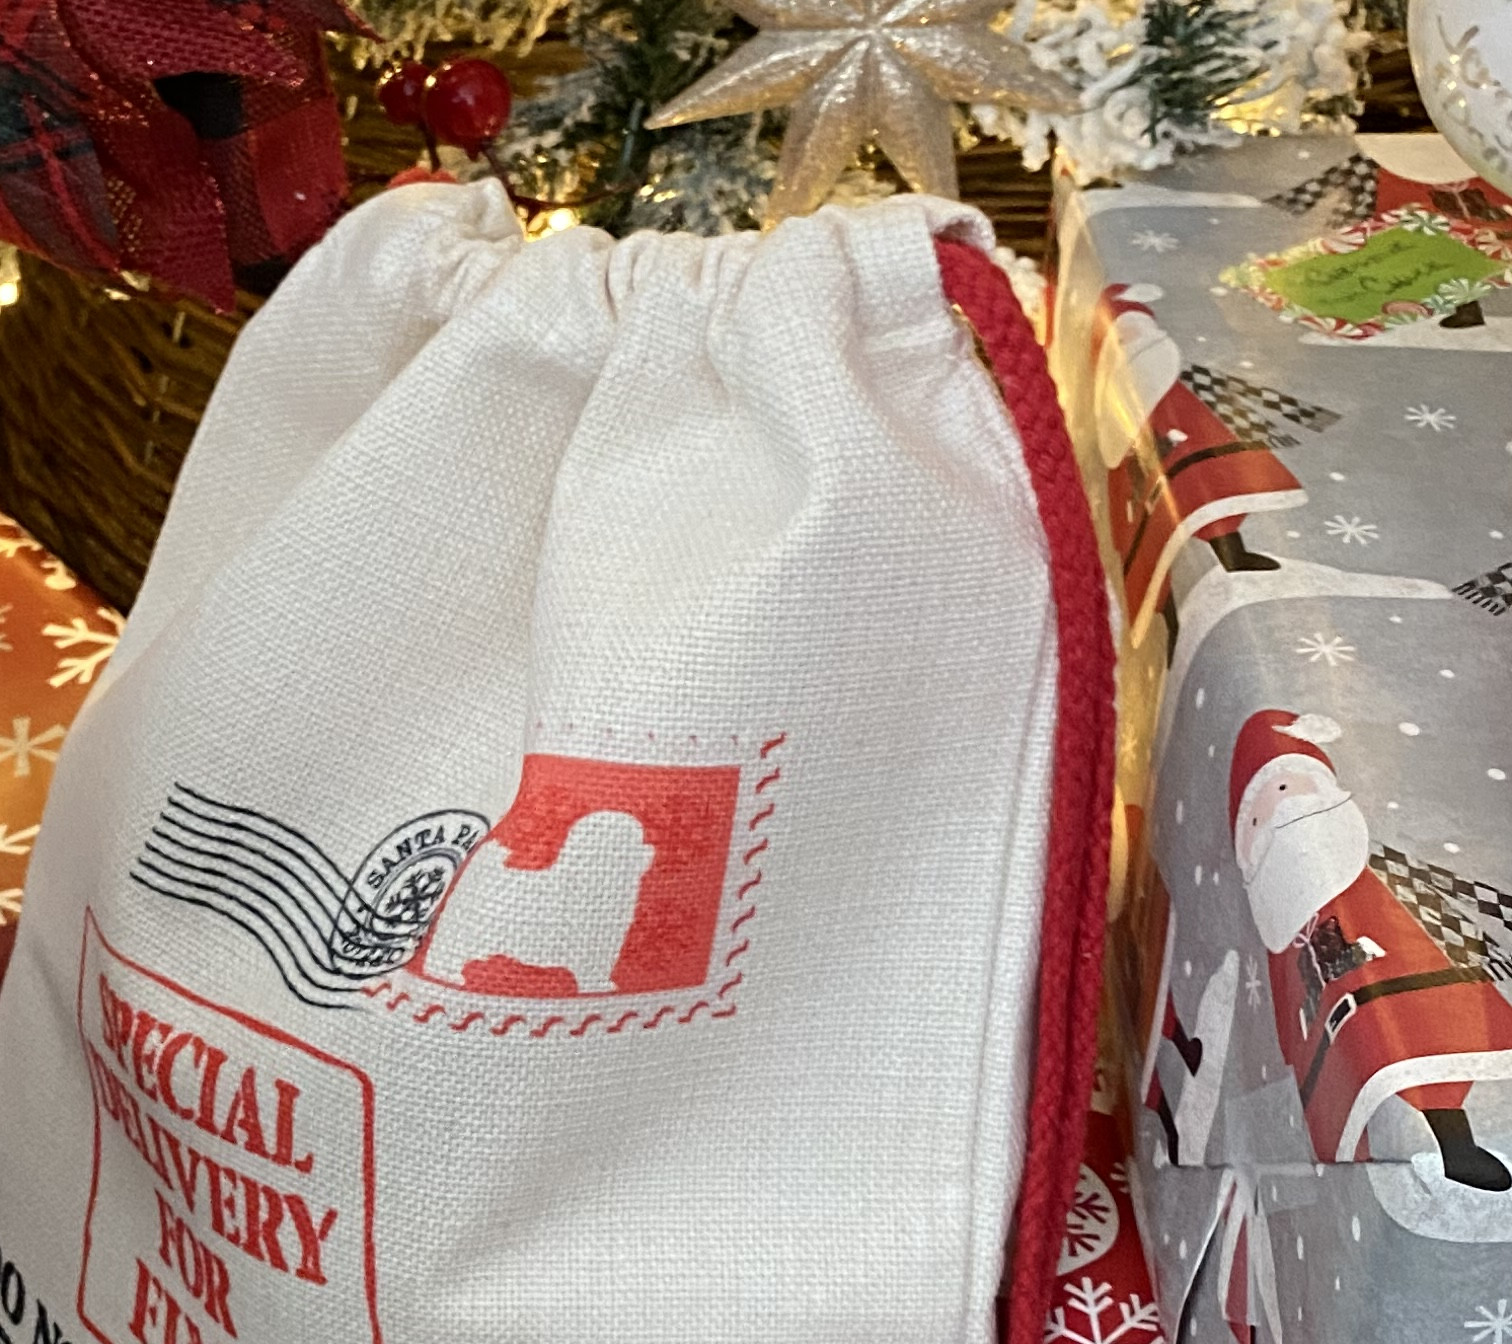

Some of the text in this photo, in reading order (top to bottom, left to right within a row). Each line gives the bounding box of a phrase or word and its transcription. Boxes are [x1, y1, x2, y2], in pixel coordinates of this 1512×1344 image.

[367, 825, 446, 890] SANTA
[98, 972, 317, 1175] SPECIAL
[92, 1054, 338, 1286] DELIVERY
[155, 1190, 238, 1339] FOR
